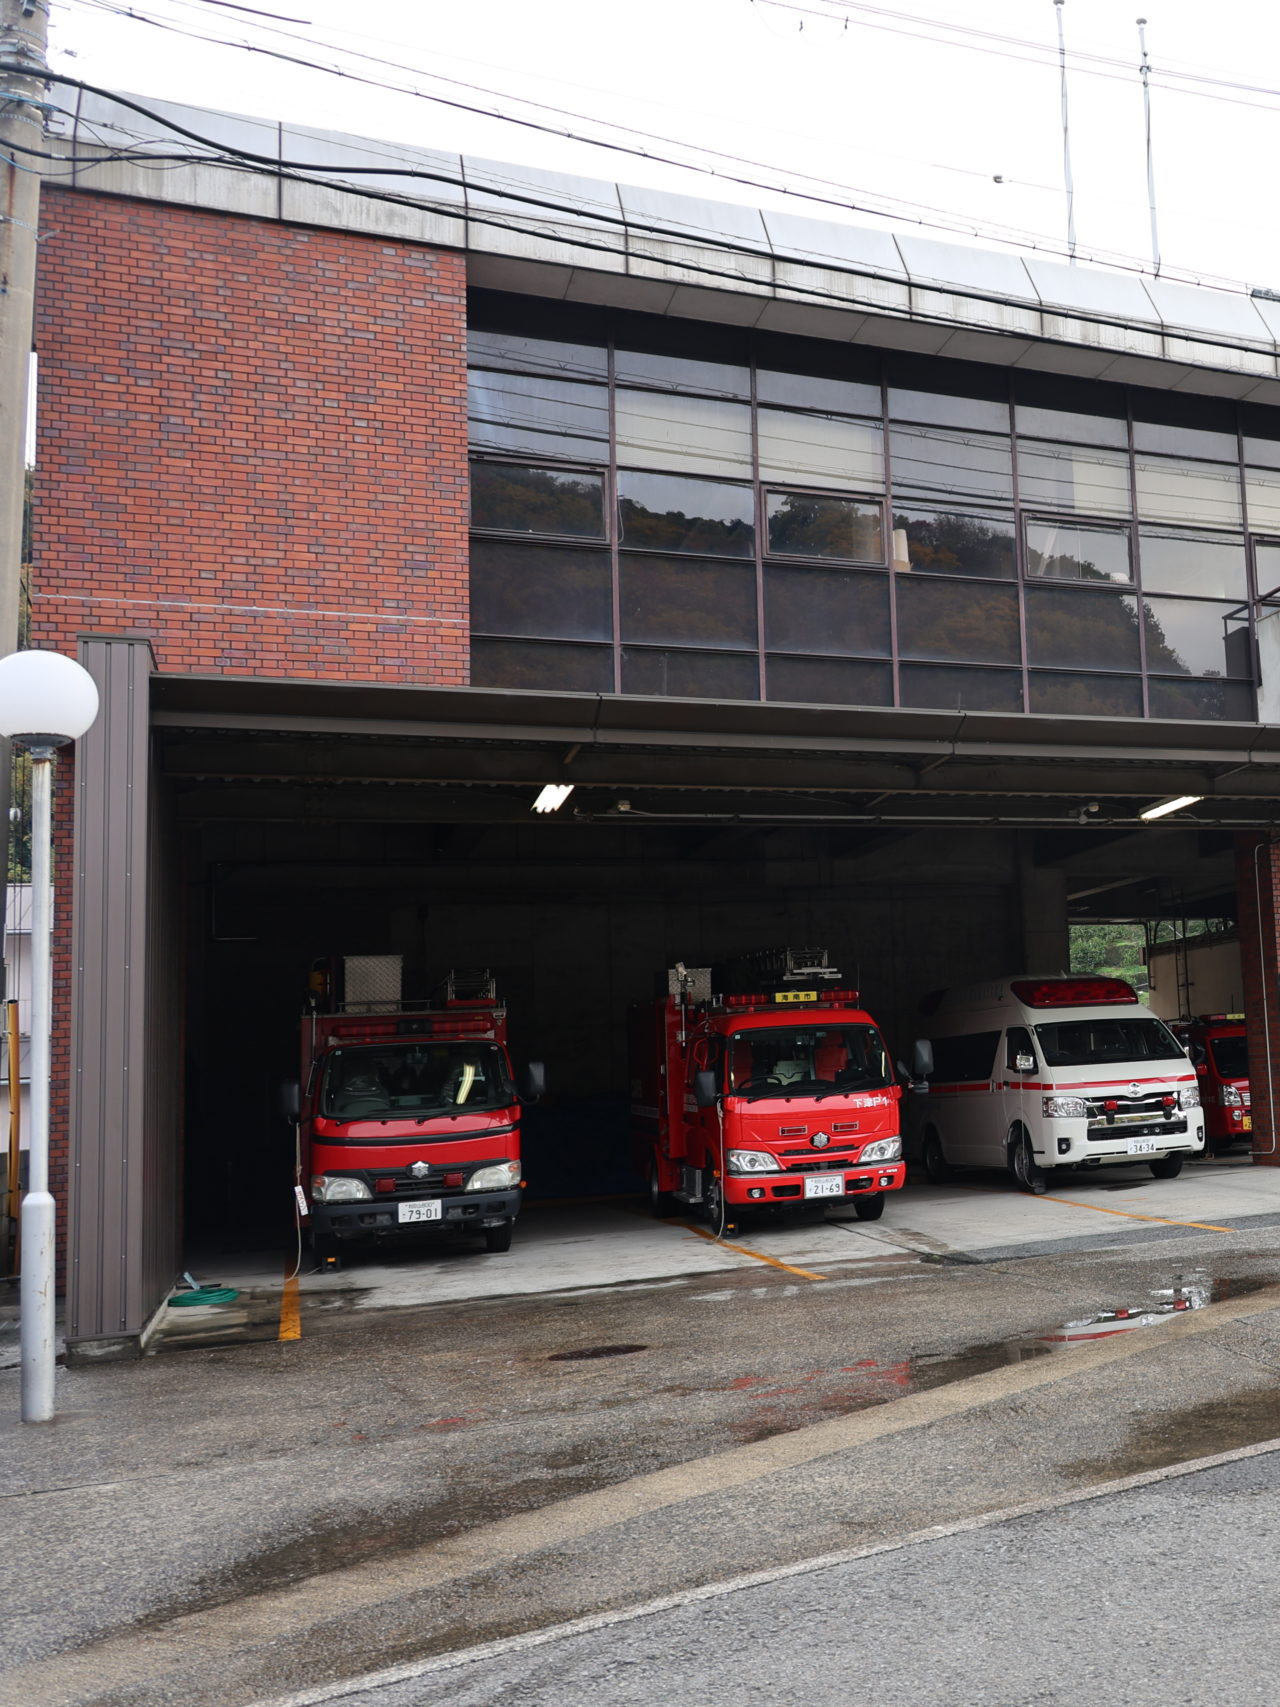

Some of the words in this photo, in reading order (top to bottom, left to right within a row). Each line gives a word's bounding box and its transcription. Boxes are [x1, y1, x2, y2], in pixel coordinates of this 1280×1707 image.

[782, 993, 811, 1001] 海南市
[408, 1207, 437, 1220] 79-01
